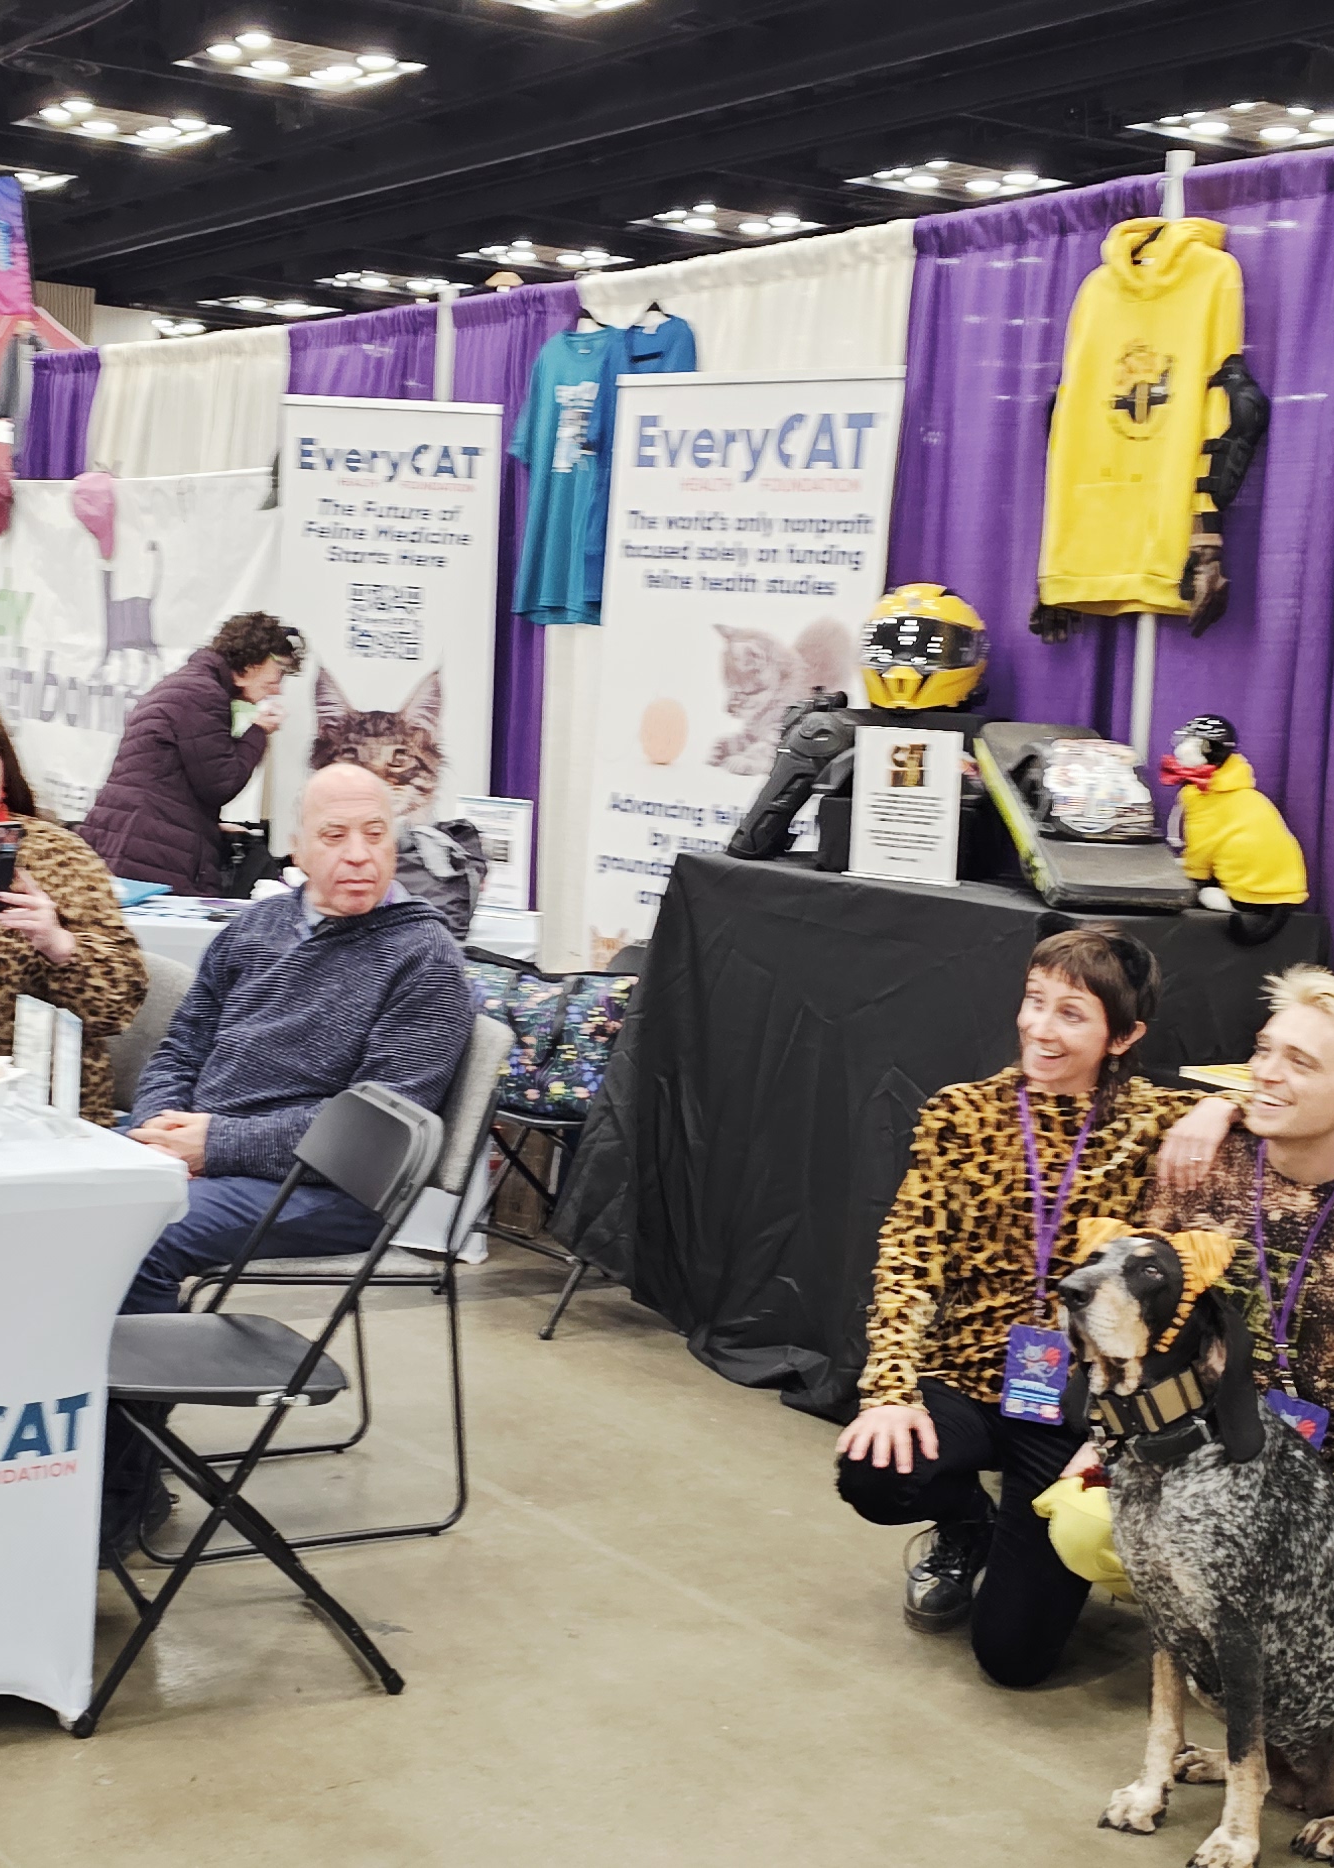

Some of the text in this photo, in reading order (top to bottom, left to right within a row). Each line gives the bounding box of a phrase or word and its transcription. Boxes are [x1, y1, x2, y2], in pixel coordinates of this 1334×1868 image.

[296, 437, 483, 482] EveryCAT
[635, 411, 879, 482] EveryCAT
[317, 498, 357, 517] The
[363, 500, 434, 522] Future
[626, 509, 875, 539] The world's only nonprofit
[302, 520, 472, 546] Feline Medicine
[325, 545, 449, 568] Starts Here
